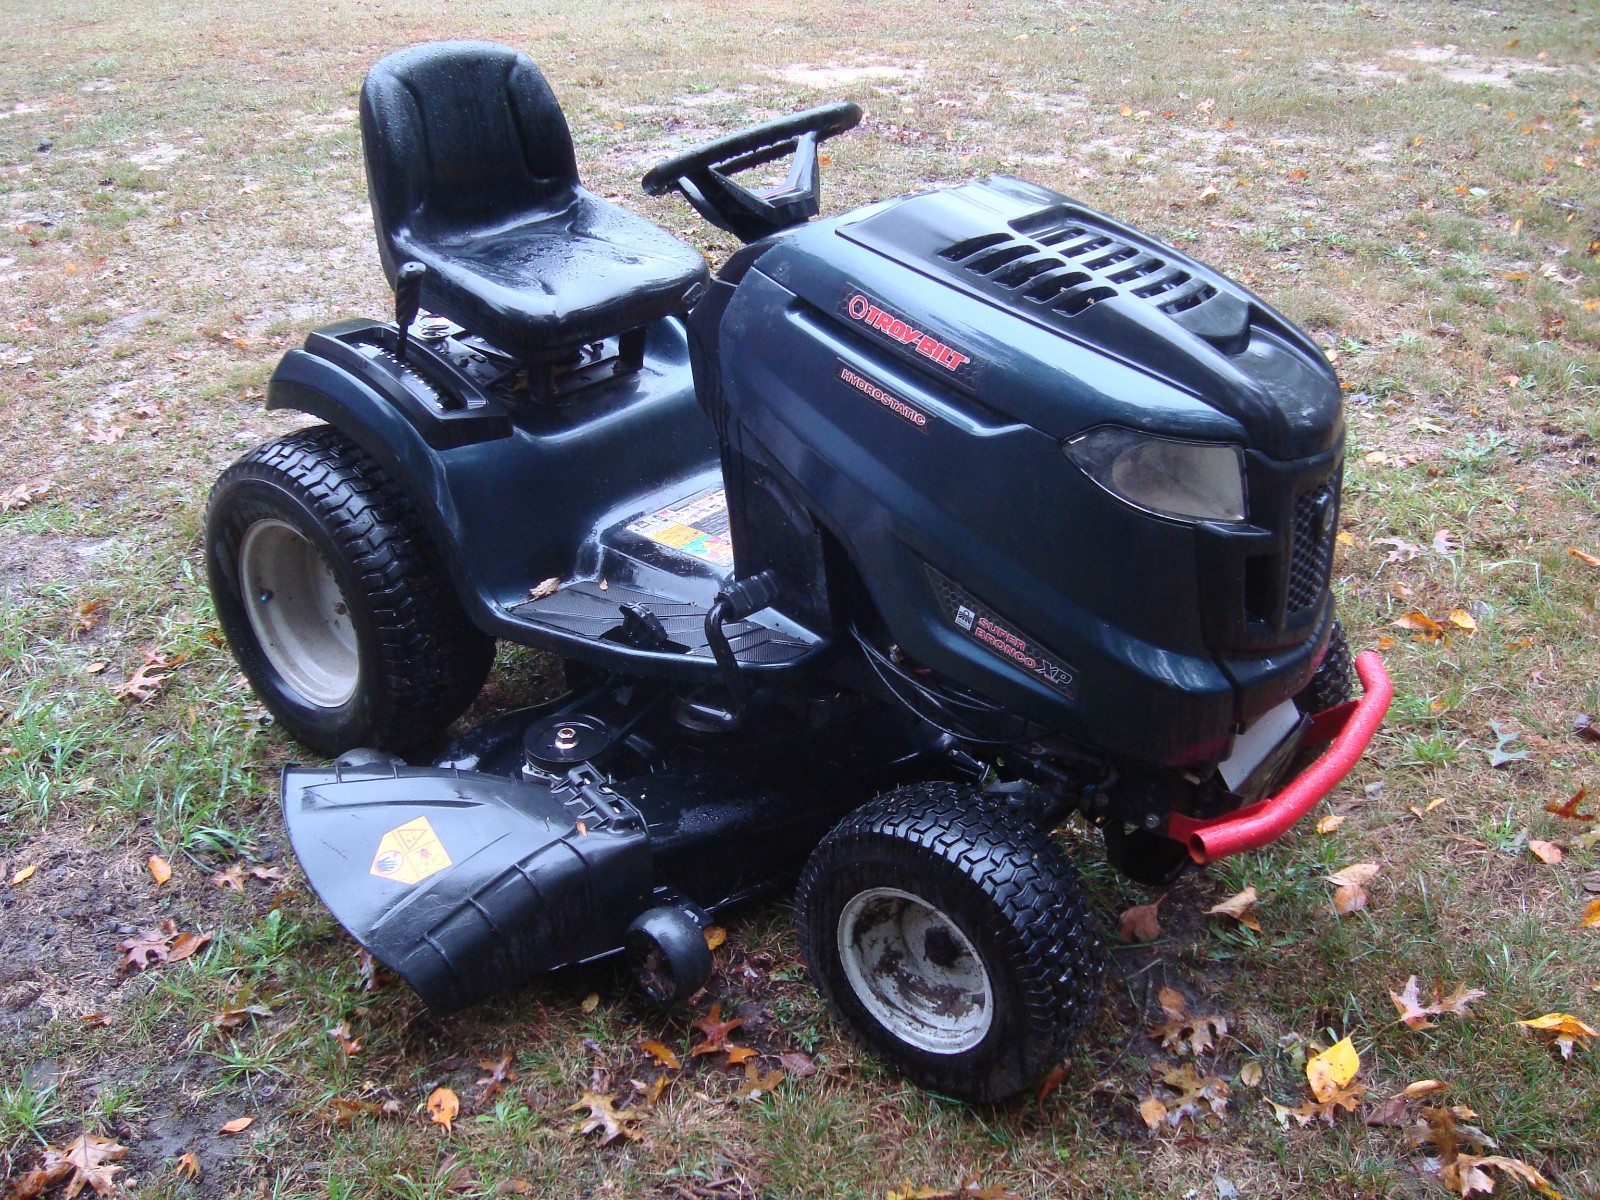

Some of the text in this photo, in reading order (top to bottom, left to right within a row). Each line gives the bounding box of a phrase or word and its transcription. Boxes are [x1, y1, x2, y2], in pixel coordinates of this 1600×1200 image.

[864, 305, 966, 371] TROY-BILT
[840, 368, 926, 426] HYDROSTATIC
[974, 627, 1073, 685] BRONCO XP
[977, 617, 1027, 651] SUPER
